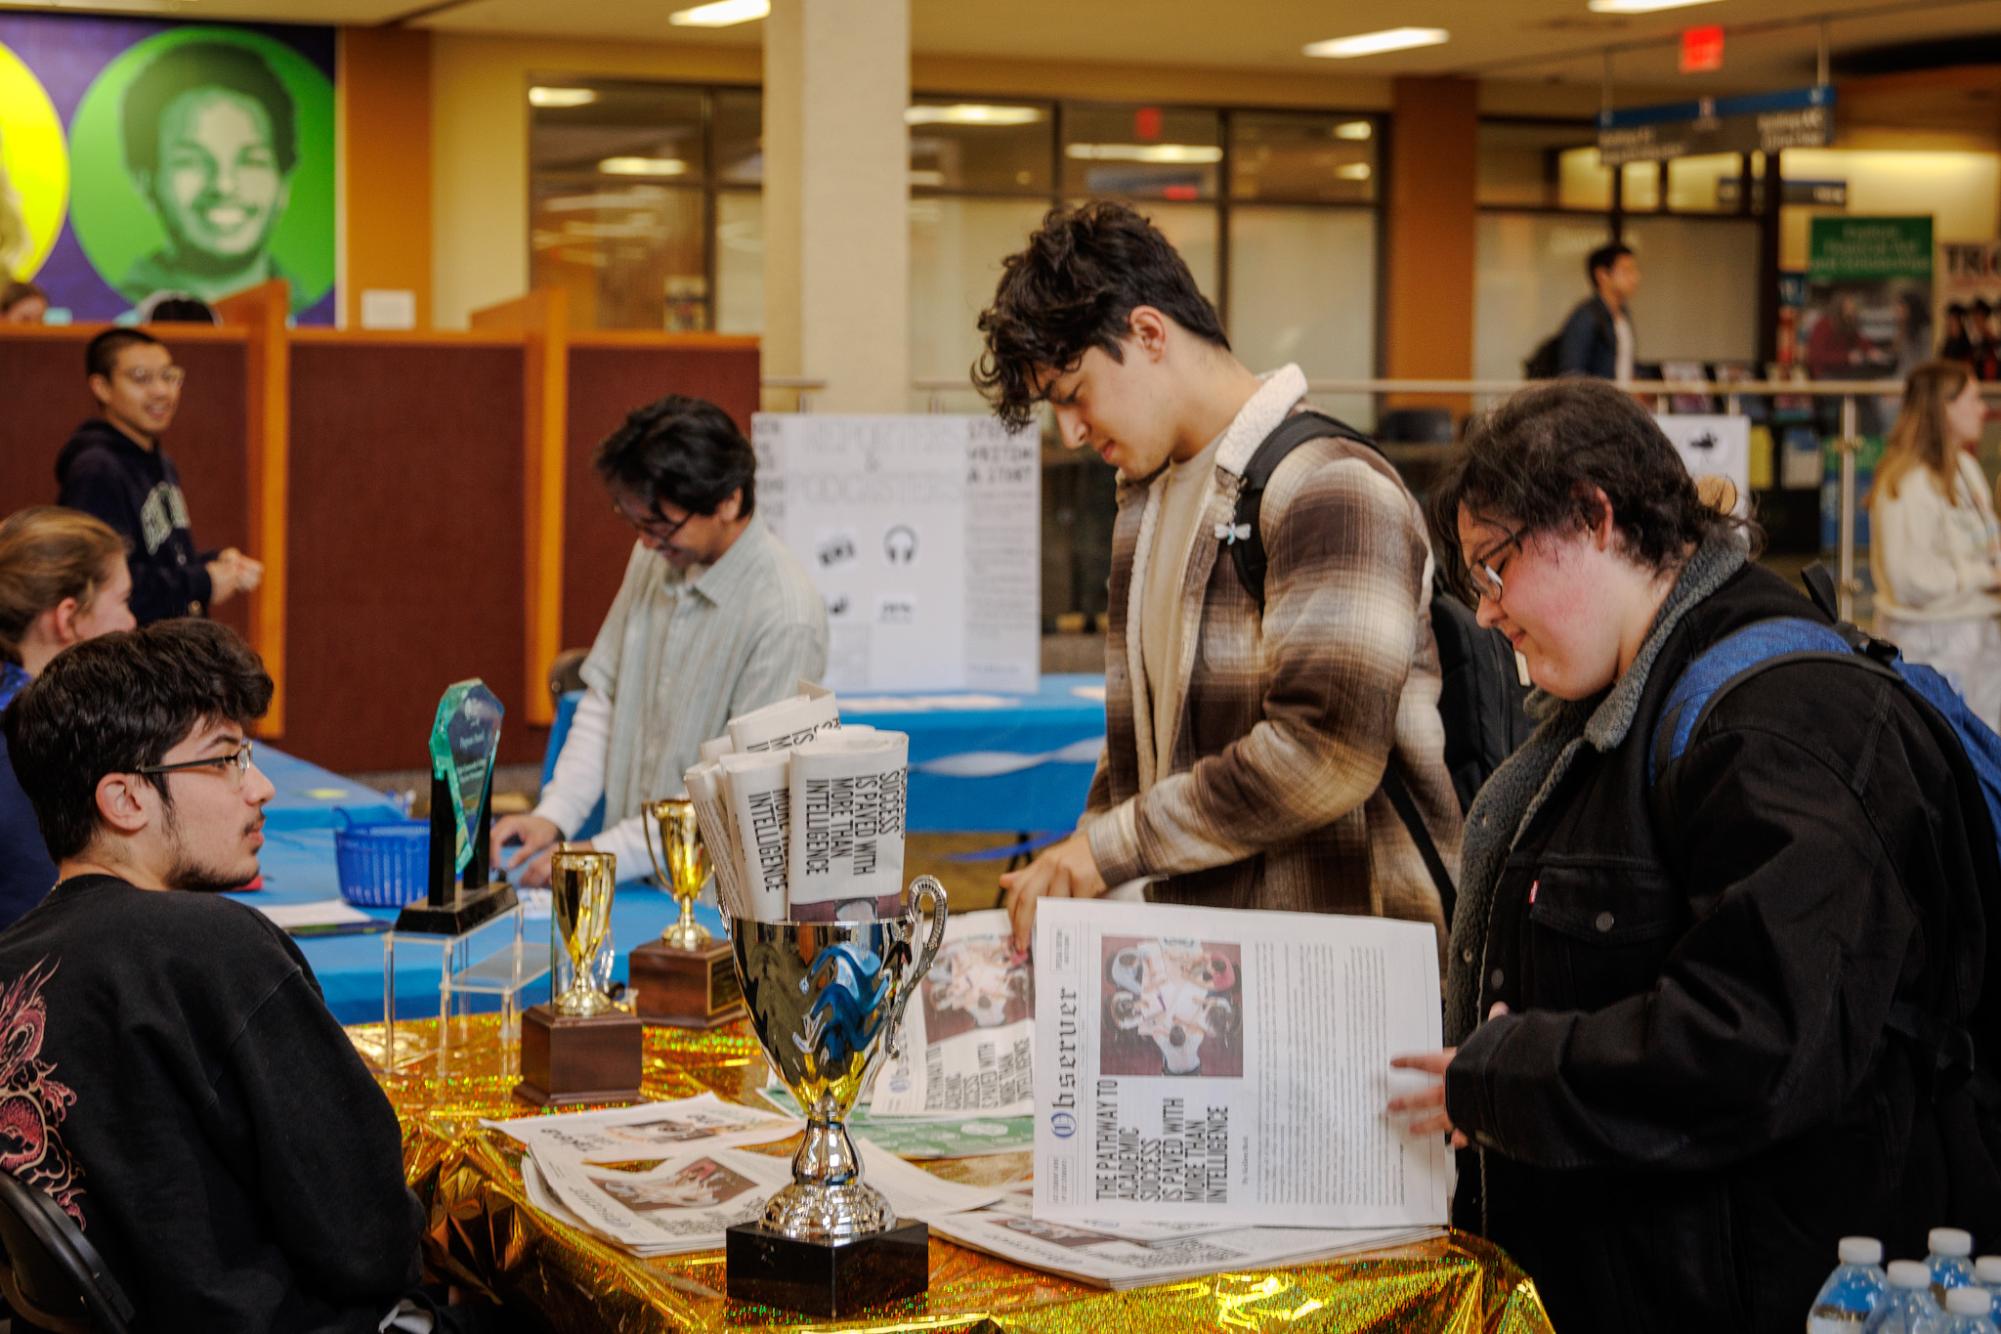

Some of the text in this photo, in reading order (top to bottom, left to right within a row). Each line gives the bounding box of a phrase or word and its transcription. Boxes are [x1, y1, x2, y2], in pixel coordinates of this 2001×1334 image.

[748, 791, 788, 893] INTELLIGENCE
[806, 779, 829, 876] INTELLIGENCE
[830, 778, 853, 859] MORE THAN
[853, 775, 878, 876] IS PAVED WITH
[879, 770, 900, 835] SUCCESS
[1050, 986, 1077, 1139] Observer
[1096, 1079, 1118, 1096] TO
[1096, 1101, 1117, 1169] PATHWAY
[1118, 1127, 1139, 1201] ACADEMIC
[1140, 1137, 1161, 1201] SUCCESS
[1162, 1097, 1184, 1202] IS PAVED WITH
[1184, 1120, 1205, 1203] MORE THAN
[1206, 1105, 1228, 1203] INTELLIGENCE
[1096, 1174, 1118, 1201] THE
